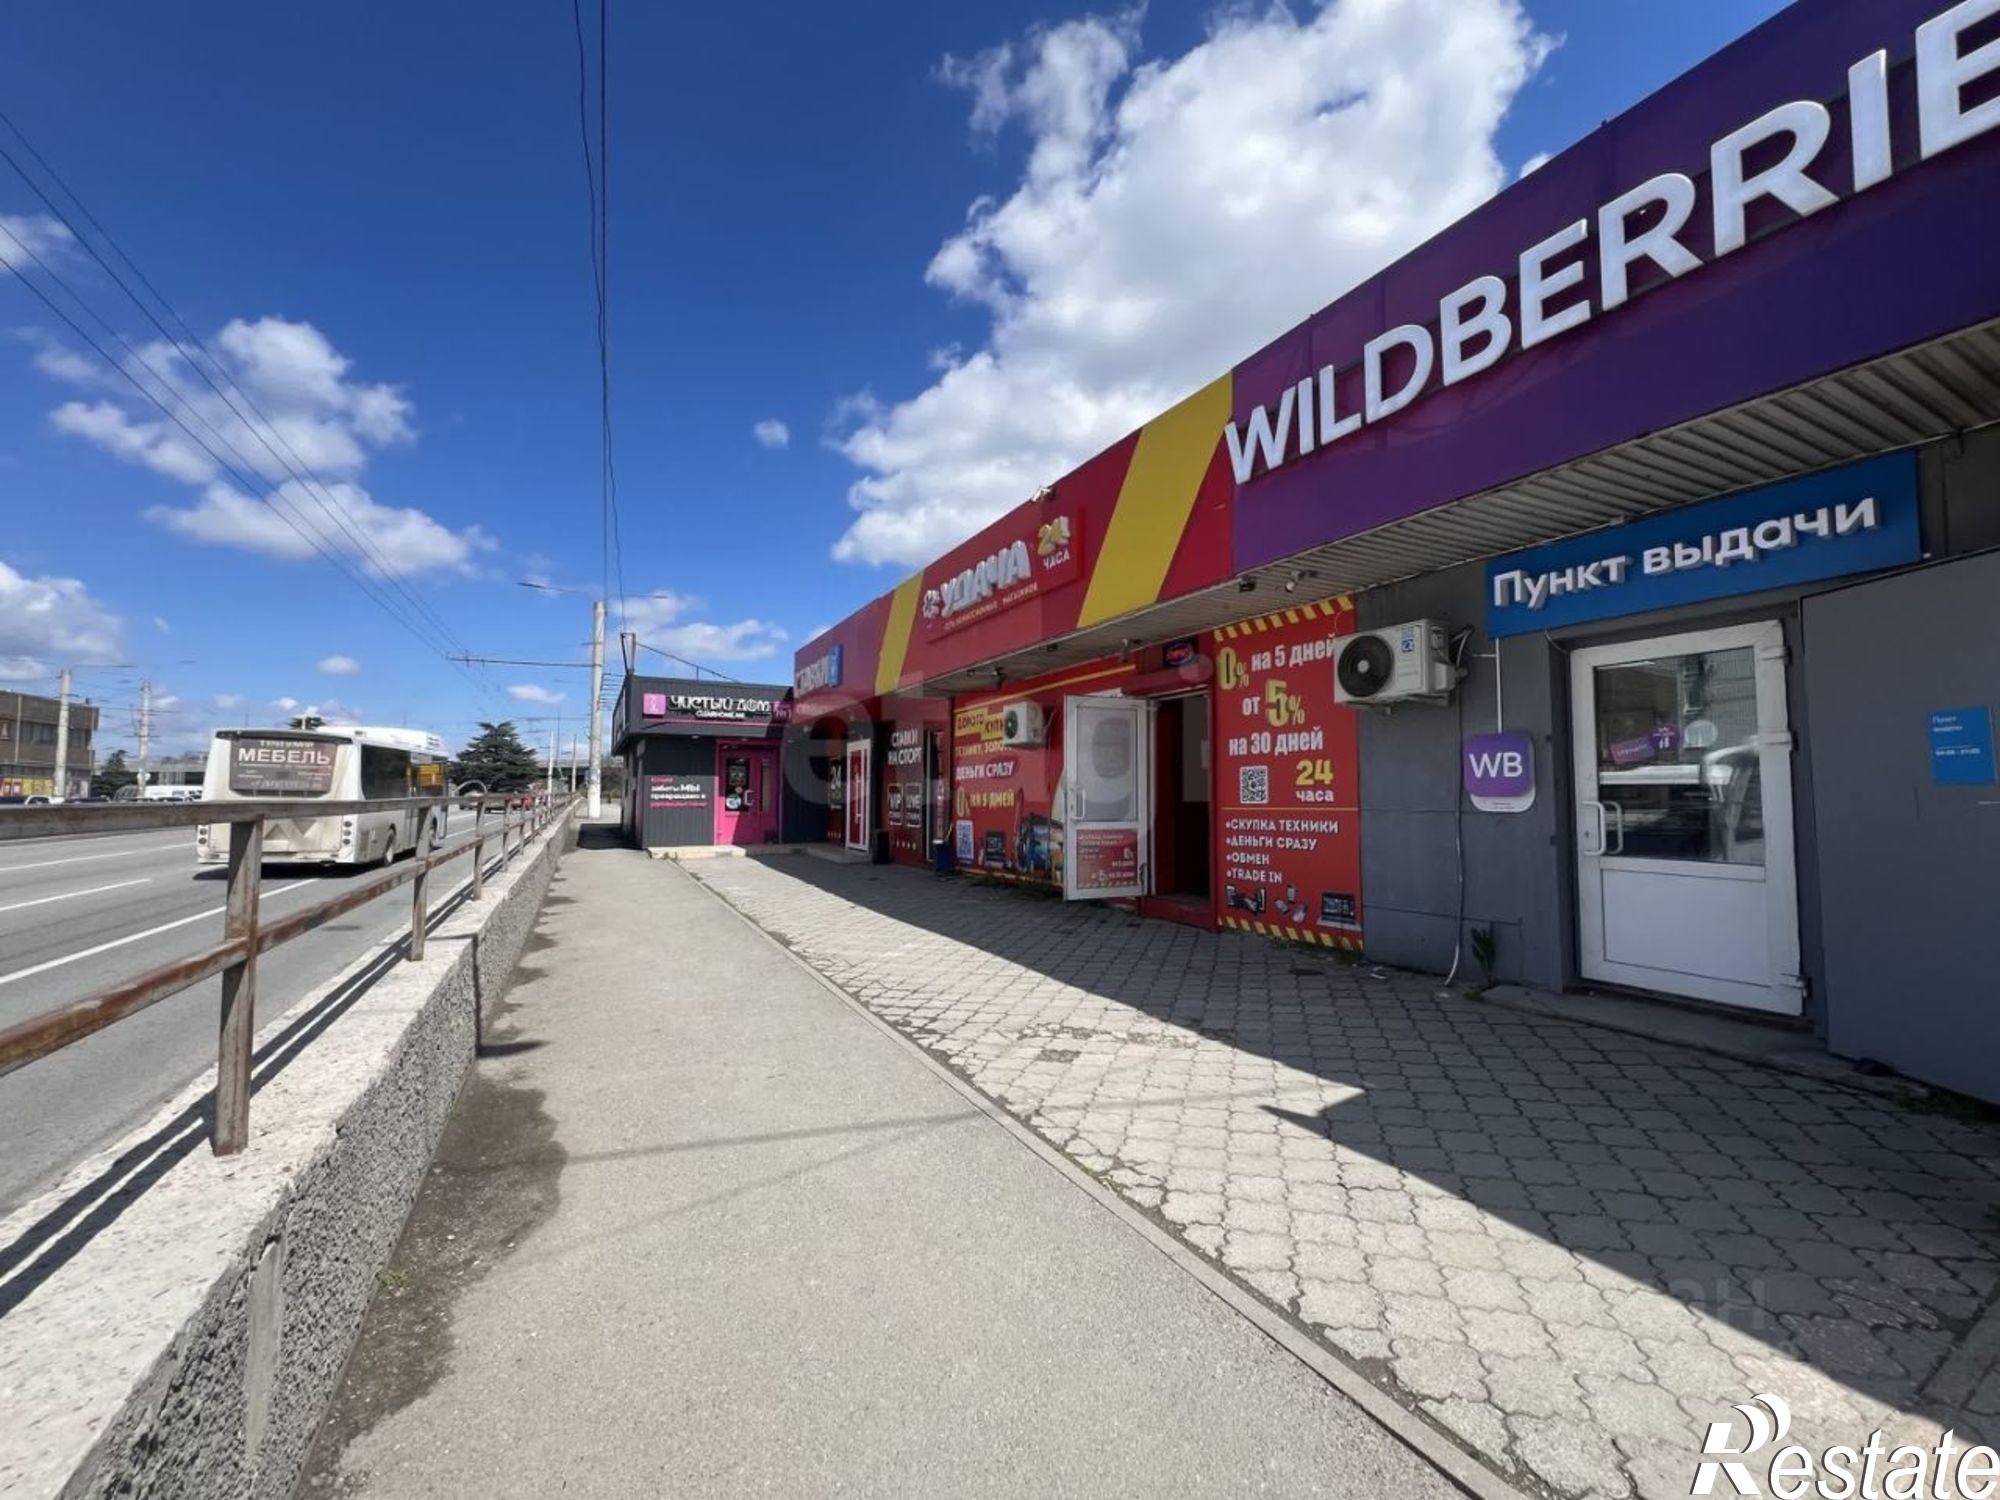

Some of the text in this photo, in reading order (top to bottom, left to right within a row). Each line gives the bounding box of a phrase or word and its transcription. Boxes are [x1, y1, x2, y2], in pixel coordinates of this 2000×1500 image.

[1038, 515, 1070, 556] 24
[1494, 497, 1876, 608] Пункт выдачи
[940, 539, 1031, 618] УДАЧА
[1251, 633, 1336, 671] на 5 дней
[1217, 647, 1249, 690] 0%
[1242, 679, 1306, 727] от 5%
[1229, 725, 1323, 756] на 30 дней
[239, 747, 330, 764] МЕБЕЛЬ
[986, 760, 1014, 778] СРАЗУ
[1469, 751, 1523, 778] WB
[1296, 759, 1334, 786] 24
[1296, 789, 1334, 803] часа
[1231, 819, 1339, 833] СКУПКА ТЕХНИКИ
[1231, 836, 1318, 851] ДЕНЬГИ СРАЗУ
[1232, 853, 1270, 866] ОБМЕН
[1231, 869, 1267, 882] TRADE
